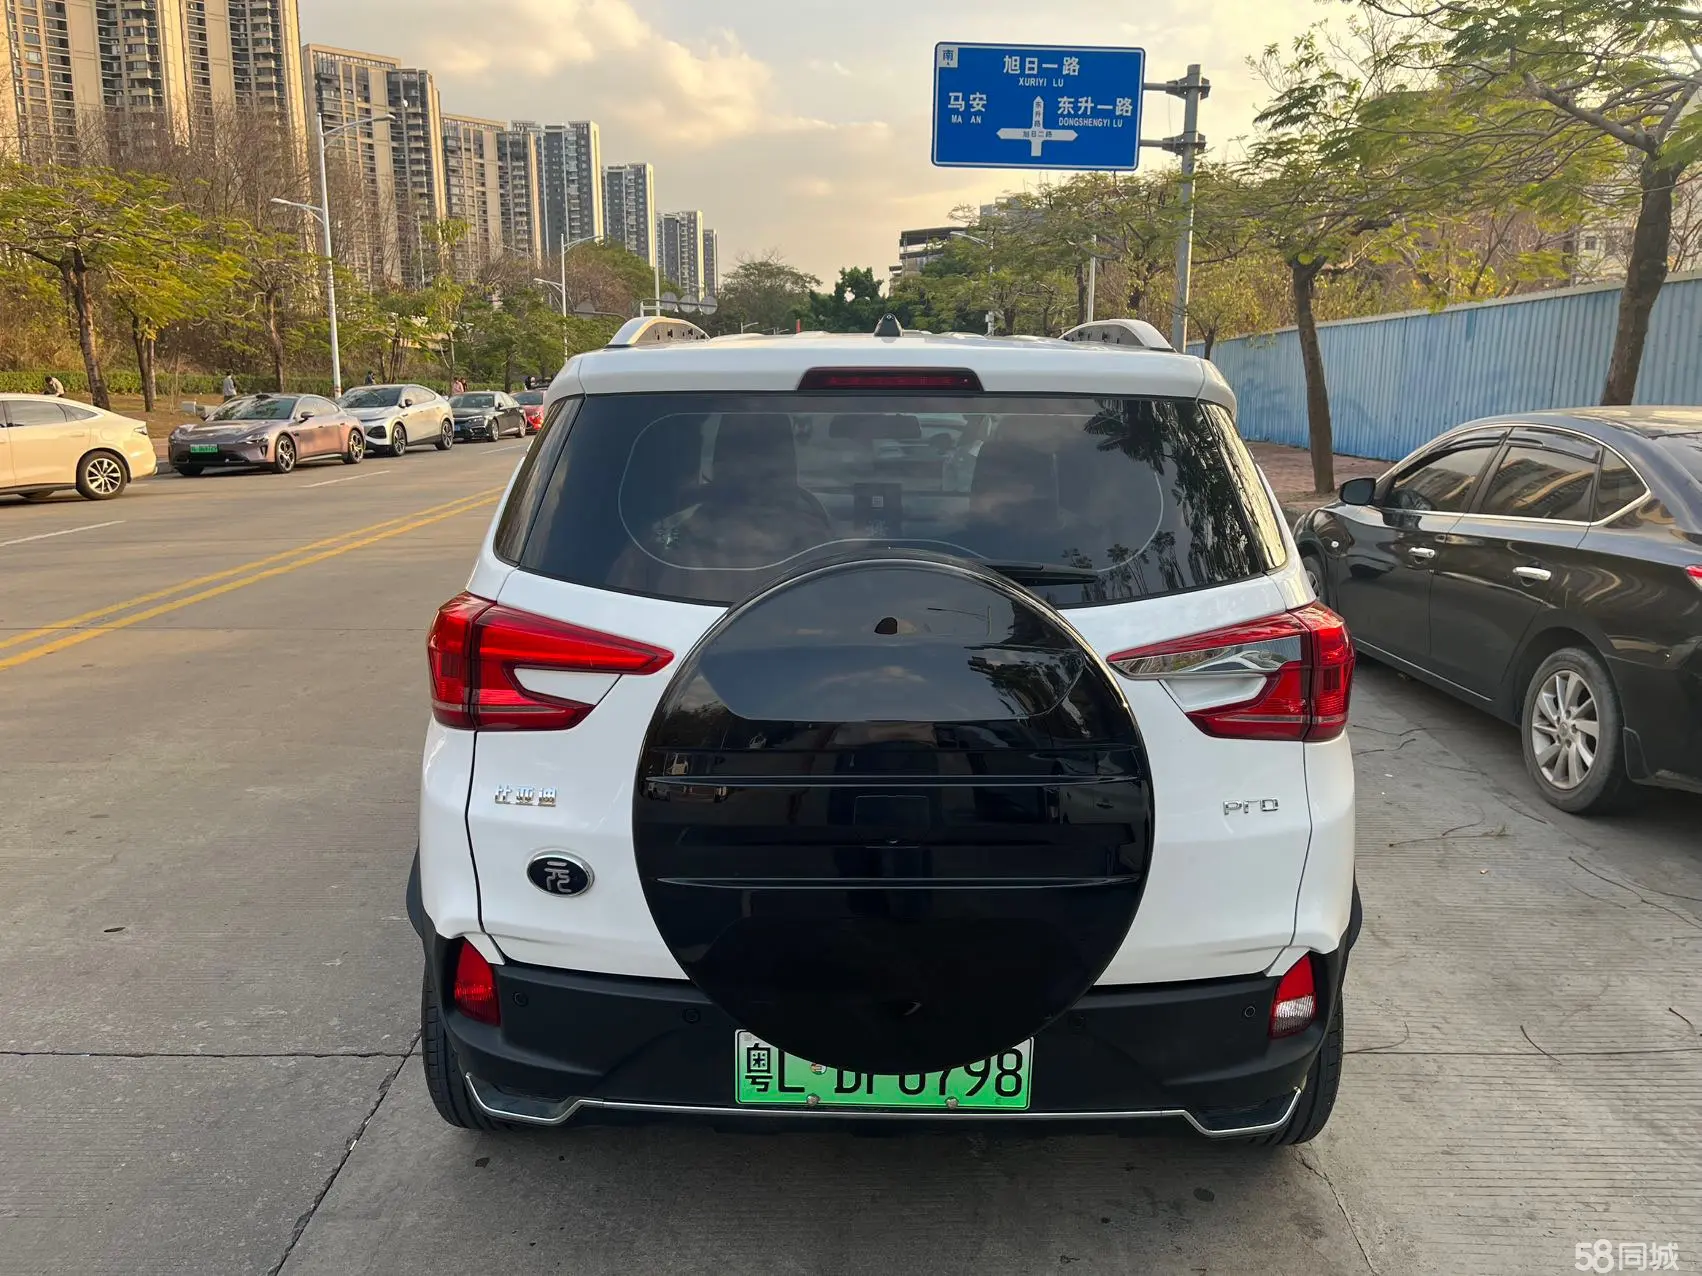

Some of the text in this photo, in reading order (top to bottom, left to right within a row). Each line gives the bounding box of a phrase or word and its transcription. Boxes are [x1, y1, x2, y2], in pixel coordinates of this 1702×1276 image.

[1003, 55, 1080, 76] 旭日一路
[1018, 77, 1064, 87] XURIYI LU
[947, 91, 988, 112] 马安
[1057, 96, 1133, 116] 东升一路
[951, 114, 982, 124] MA AN
[1058, 117, 1123, 128] DONGSHENGYI LU
